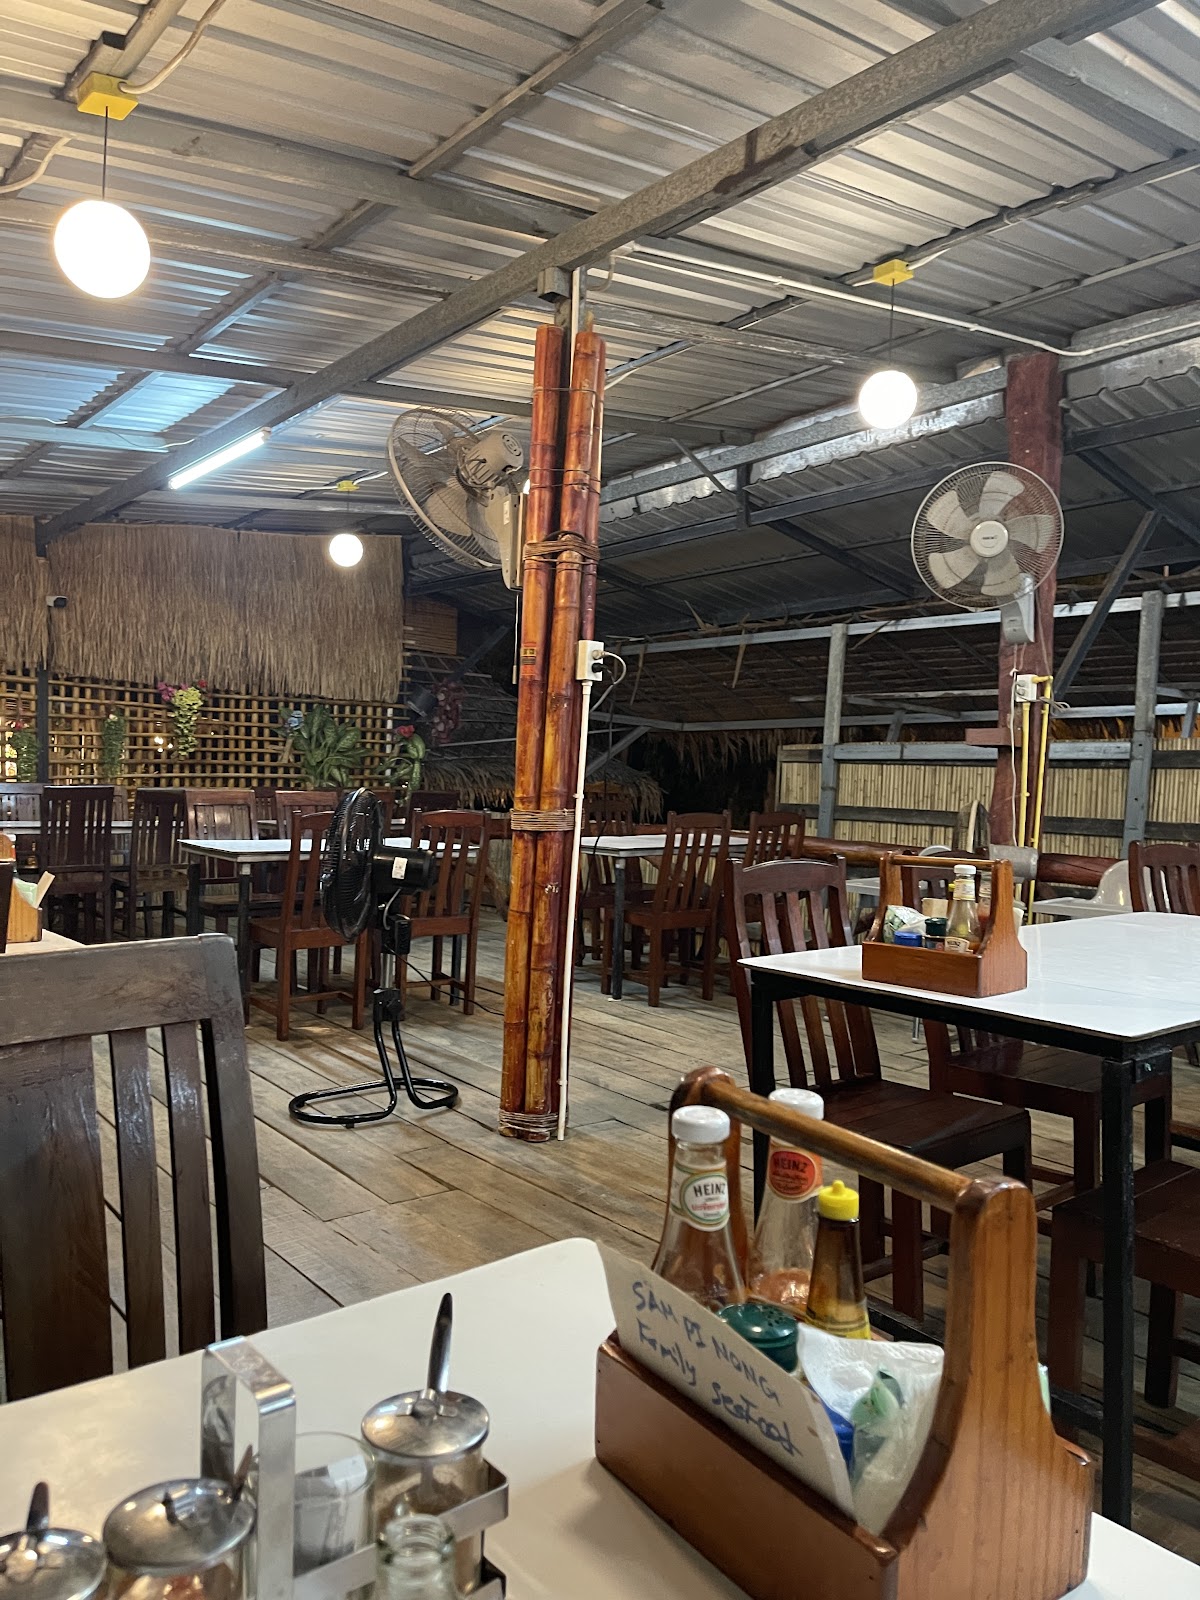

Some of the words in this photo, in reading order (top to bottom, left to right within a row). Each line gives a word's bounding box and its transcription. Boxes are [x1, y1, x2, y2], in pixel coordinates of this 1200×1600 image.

[773, 1157, 808, 1174] HEINZ
[693, 1182, 726, 1198] HEINZ
[632, 1281, 680, 1325] SAM
[711, 1336, 781, 1407] NONG
[636, 1316, 697, 1387] Family
